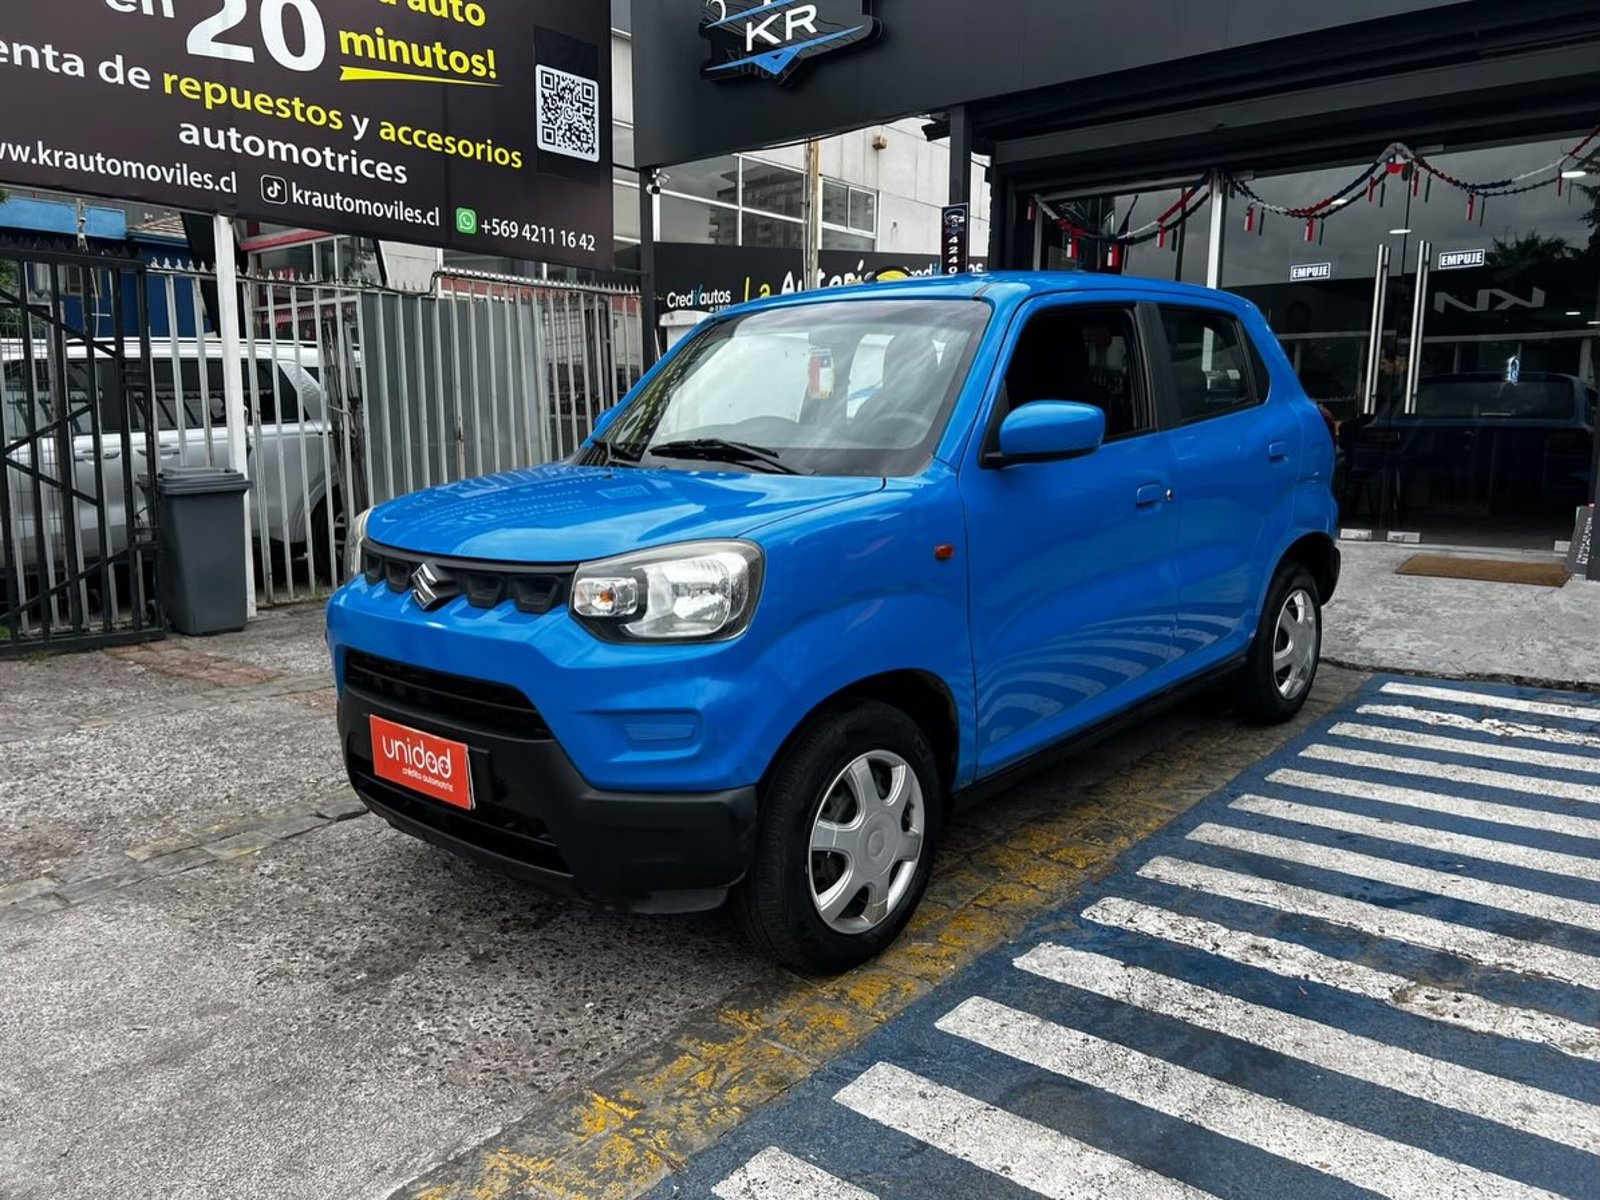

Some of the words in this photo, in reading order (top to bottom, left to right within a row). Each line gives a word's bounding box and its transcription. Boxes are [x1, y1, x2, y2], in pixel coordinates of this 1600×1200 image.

[186, 0, 327, 72] 20
[339, 27, 497, 79] minutos!
[746, 4, 818, 52] KR
[98, 54, 151, 90] de
[162, 72, 344, 130] repuestos
[351, 114, 370, 141] y
[379, 120, 523, 169] accesorios
[178, 122, 408, 184] automotrices
[291, 181, 440, 227] krautomoviles.cl
[480, 217, 519, 239] +569
[522, 222, 556, 246] 4211
[560, 229, 577, 249] 16
[579, 233, 596, 252] 42
[1292, 265, 1329, 279] EMPUJE
[1441, 252, 1483, 266] EMPUJE
[382, 735, 453, 779] unidad
